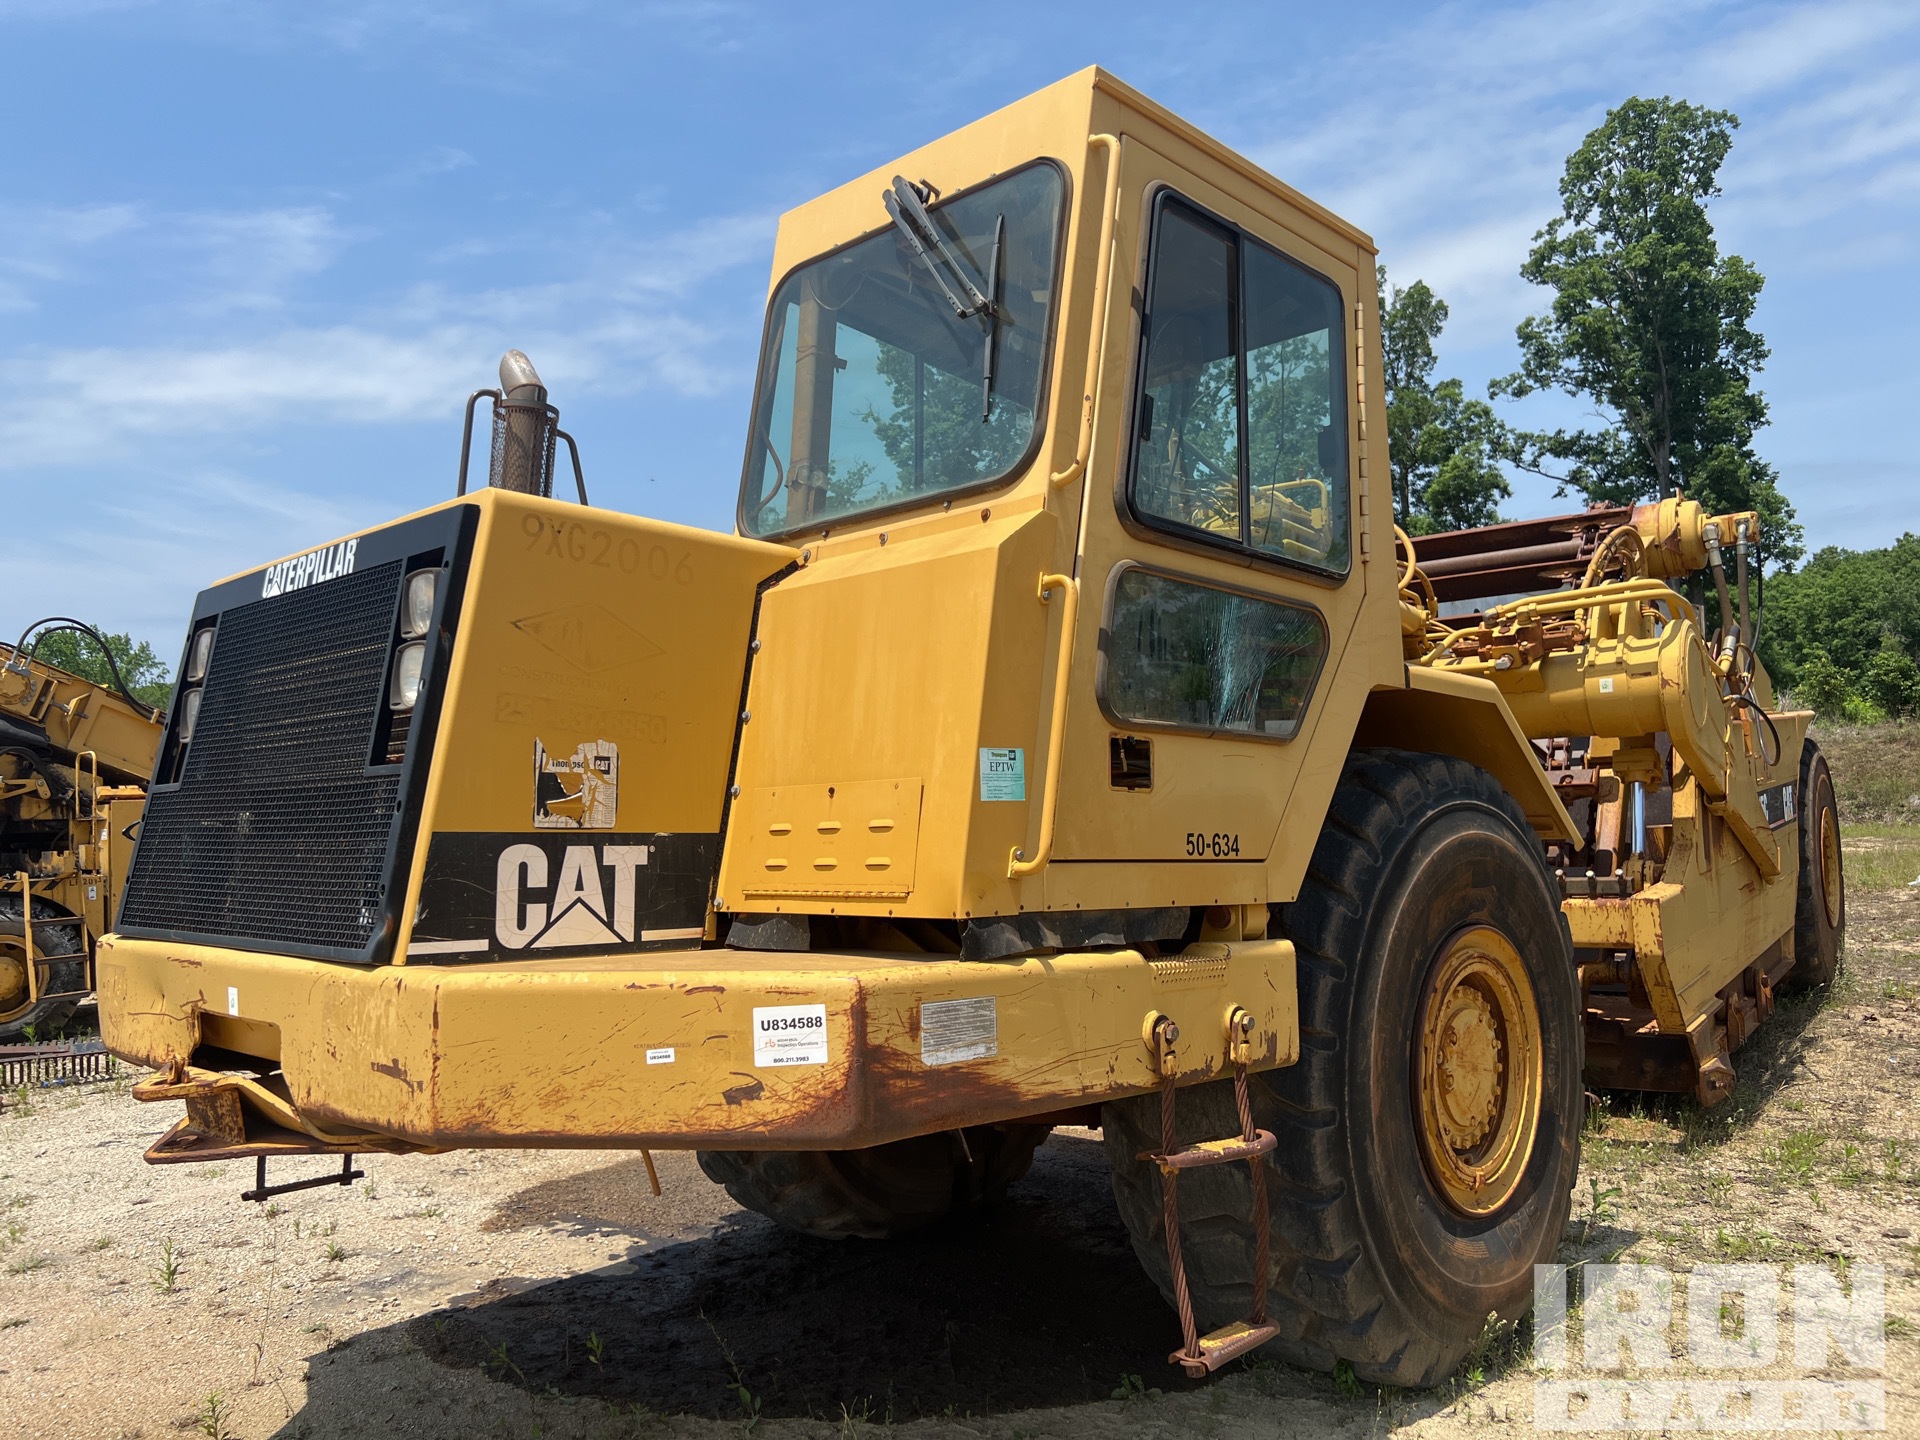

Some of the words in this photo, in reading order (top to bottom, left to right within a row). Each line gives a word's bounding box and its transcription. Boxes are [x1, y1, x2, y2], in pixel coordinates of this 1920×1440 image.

[520, 512, 695, 587] 9XG2006
[262, 538, 359, 599] CATERPILLAR
[989, 761, 1016, 772] EPTW
[1186, 832, 1240, 857] 50-634
[495, 843, 649, 949] CAT
[760, 1016, 823, 1032] U834588
[773, 1056, 810, 1064] 800.211.3983
